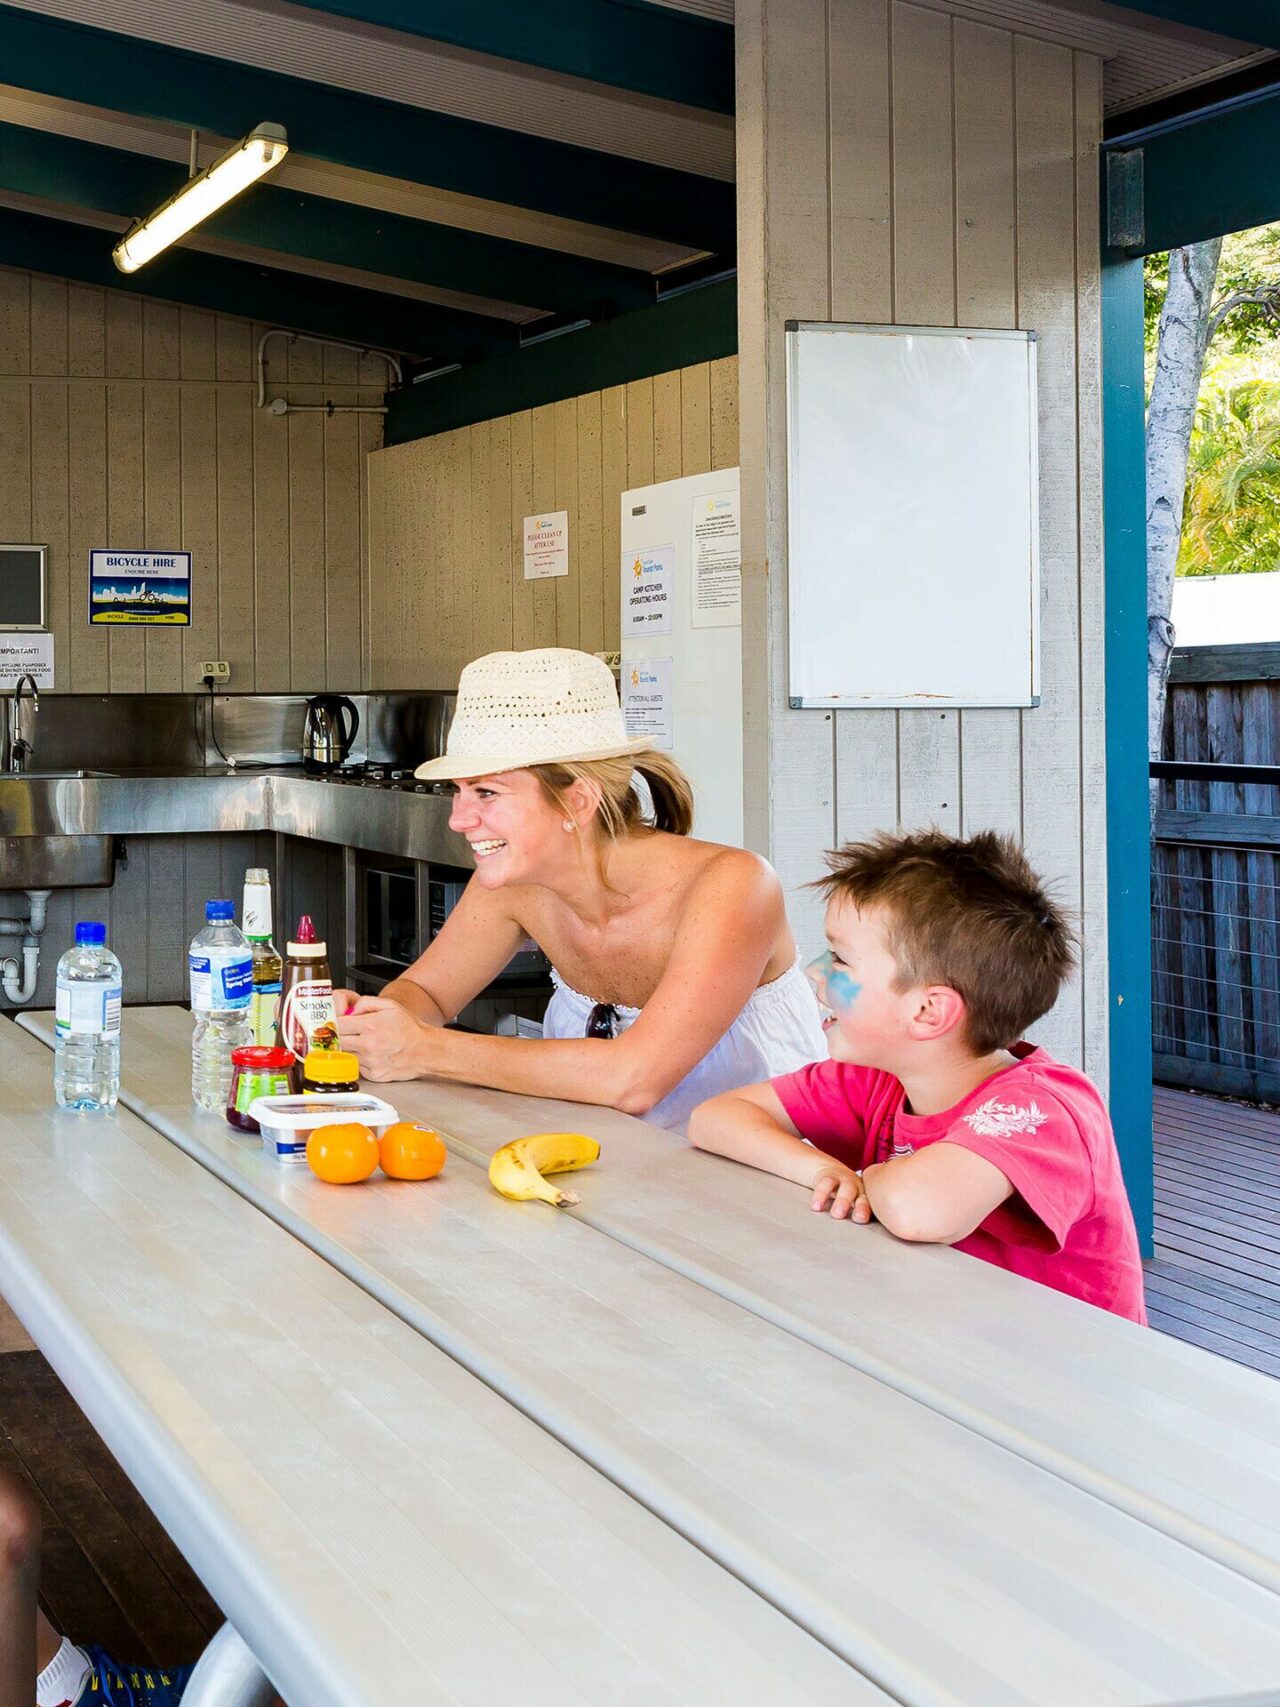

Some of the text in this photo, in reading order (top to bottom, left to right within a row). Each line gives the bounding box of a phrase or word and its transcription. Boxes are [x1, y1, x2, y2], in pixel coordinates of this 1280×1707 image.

[106, 557, 177, 568] BICYCLE HIRE
[633, 583, 663, 594] CAMP KITCHEN
[629, 593, 668, 606] OPERATING HOURS
[300, 1000, 332, 1010] Smokey
[311, 1010, 328, 1021] BBQ
